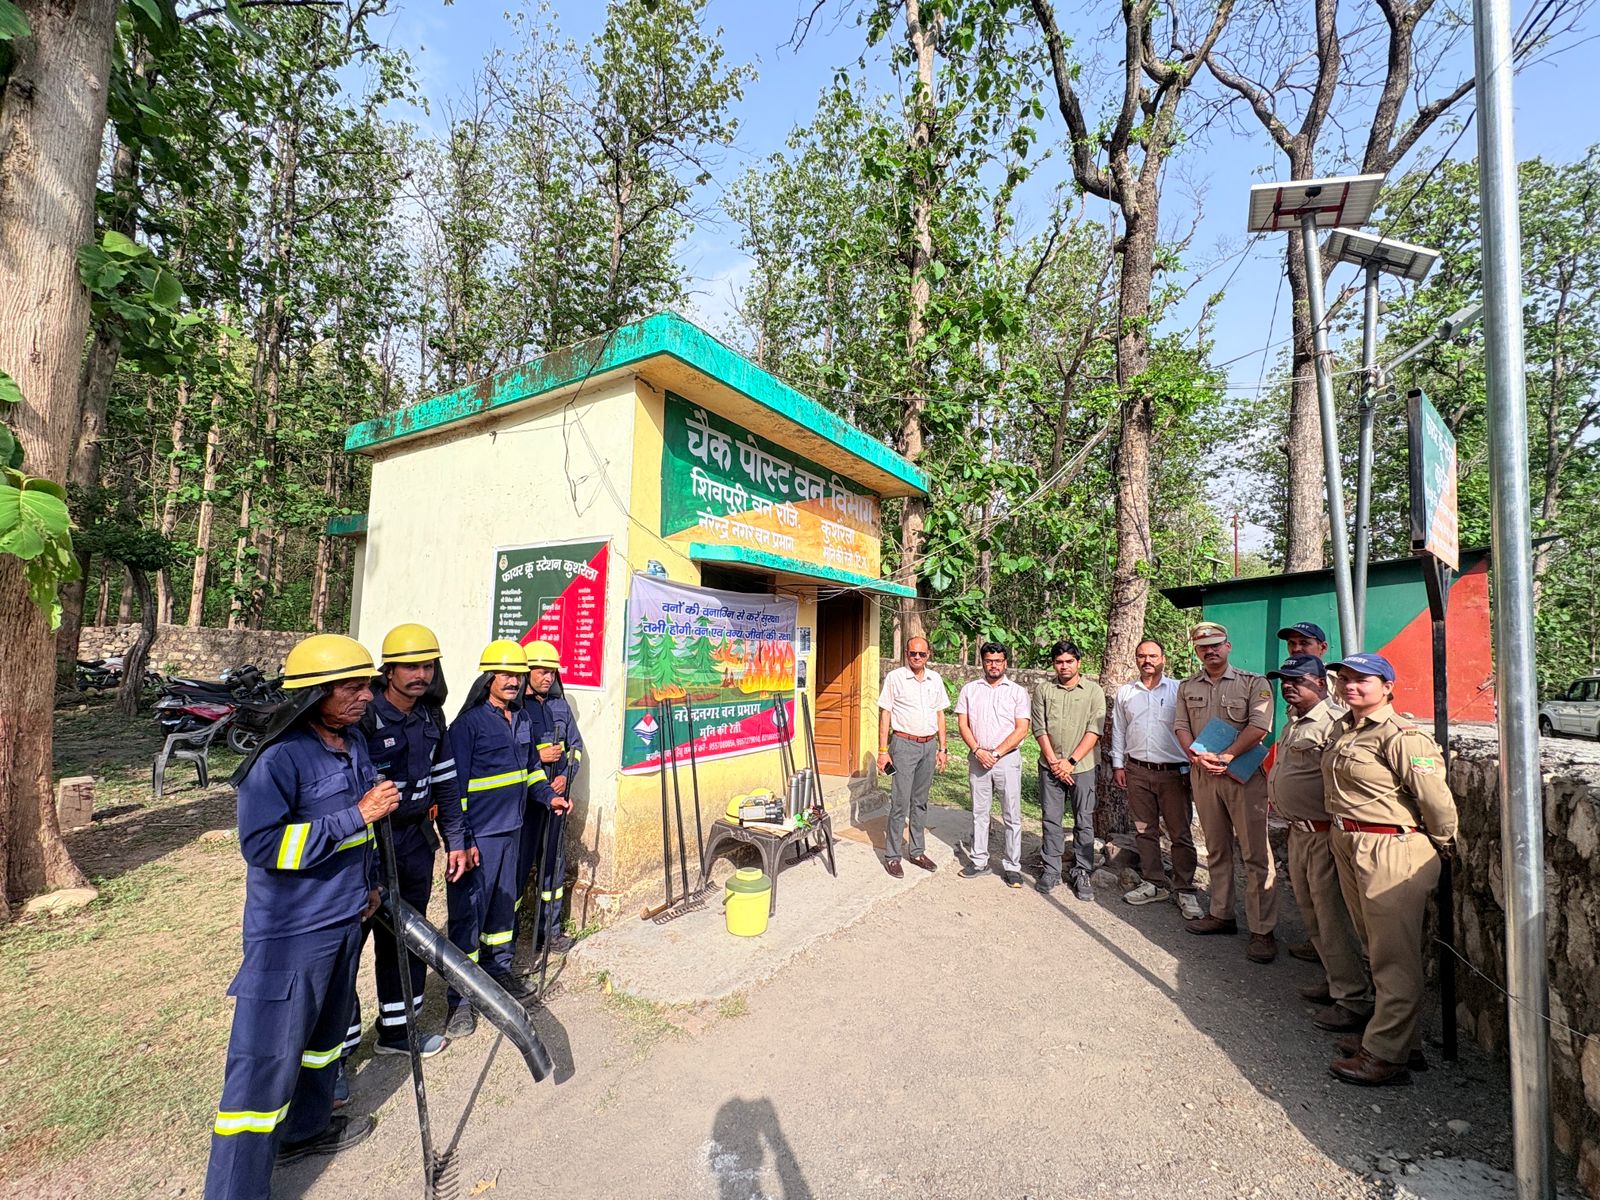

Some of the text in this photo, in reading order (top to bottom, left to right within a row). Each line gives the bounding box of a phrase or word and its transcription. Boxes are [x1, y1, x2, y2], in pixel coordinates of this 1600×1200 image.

[685, 409, 873, 523] चैक पोस्ट वन विभाग
[690, 466, 749, 517] शिवपुरी
[750, 494, 774, 520] वन
[696, 506, 730, 540] नरेन्द्र
[730, 520, 755, 544] नगर
[771, 532, 795, 552] प्रभाग
[501, 555, 599, 583] फायर क्रू स्टेशन कुशरैला
[662, 600, 780, 626] वनों की वनाग्नि से करें सुरक्षा
[642, 619, 791, 641] तभी होगी वन एवं वन्य जीवों की रक्षा
[721, 706, 735, 718] वन
[737, 703, 761, 716] प्रभाग
[699, 721, 741, 740] मुनि की रेती
